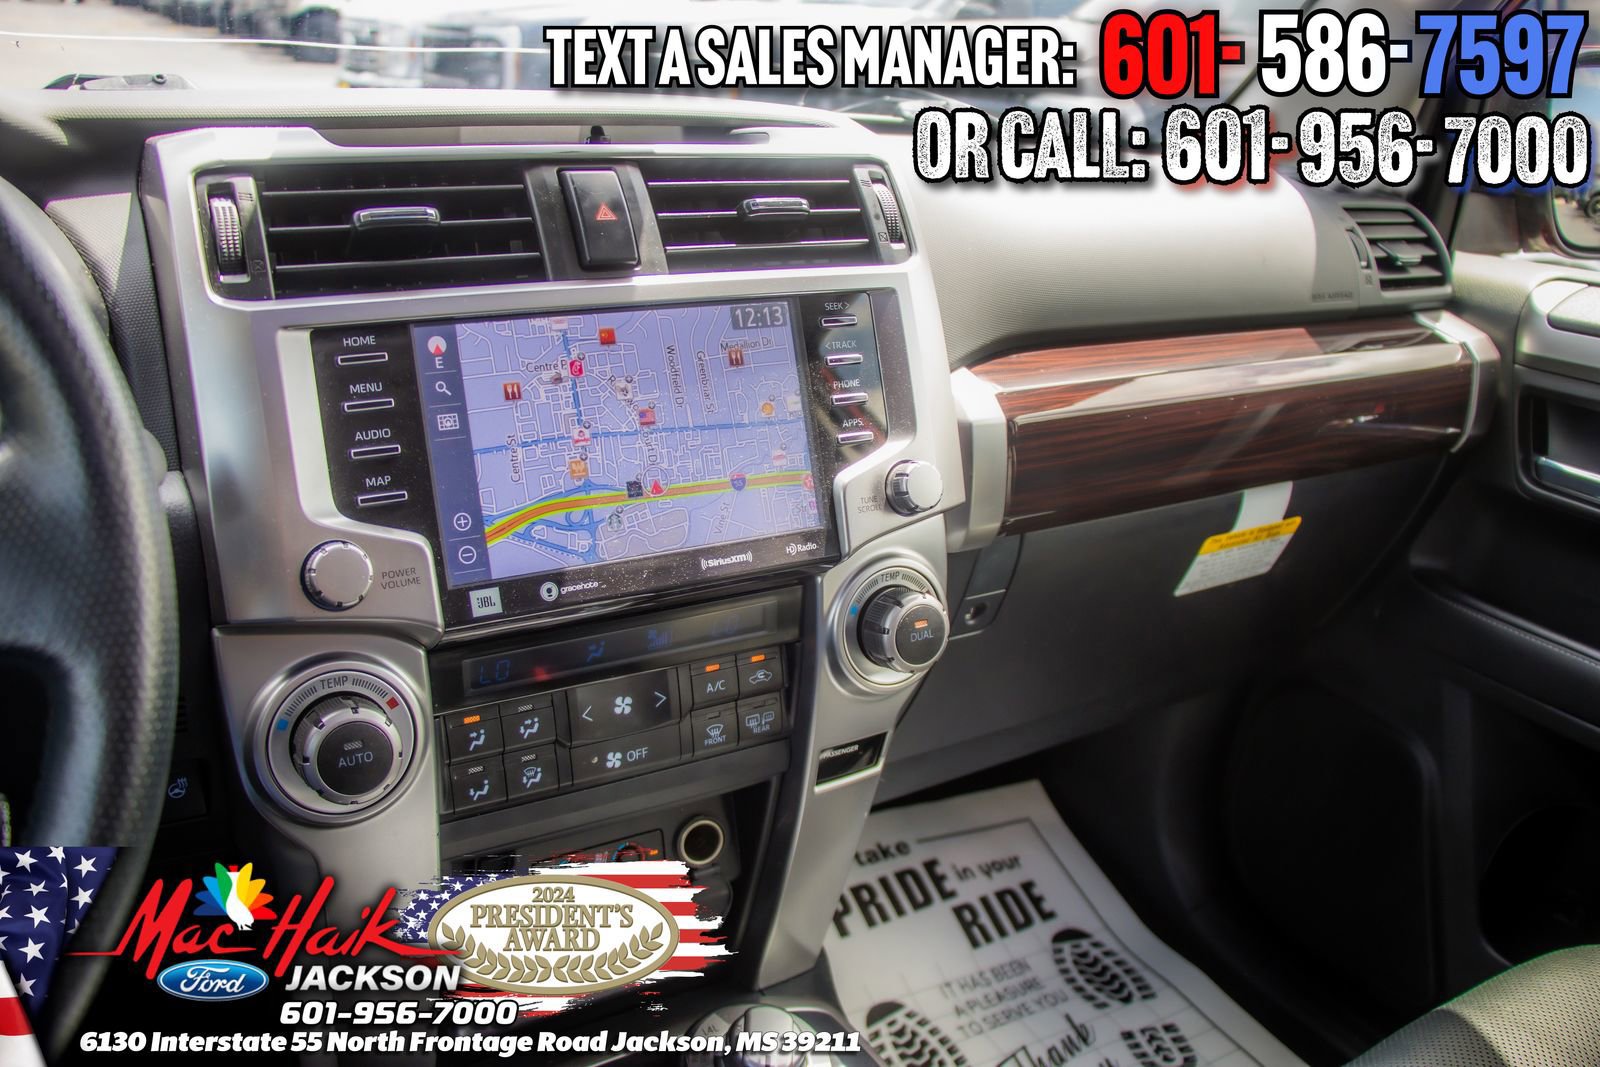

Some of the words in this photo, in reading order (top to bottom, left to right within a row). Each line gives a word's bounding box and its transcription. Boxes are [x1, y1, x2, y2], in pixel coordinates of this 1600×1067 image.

[824, 302, 843, 311] SEEK
[735, 306, 784, 328] 12:13
[343, 335, 376, 347] HOME
[720, 339, 759, 351] Medallion
[832, 340, 857, 349] TRACK
[435, 357, 444, 369] E
[526, 363, 558, 373] Centre
[666, 344, 682, 398] Woodfield
[675, 397, 683, 409] Dr
[697, 350, 713, 402] Greenbriar
[350, 382, 383, 394] MENU
[833, 378, 861, 389] PHONE
[842, 418, 863, 428] APPS
[355, 428, 391, 441] AUDIO
[507, 433, 517, 446] St
[640, 430, 655, 454] ourt
[510, 447, 521, 482] Centre
[365, 475, 391, 488] MAP
[860, 496, 878, 505] TUNE
[857, 503, 883, 514] SCROLL
[713, 513, 727, 535] Vine
[797, 542, 817, 553] Radio
[382, 567, 416, 580] POWER
[880, 571, 901, 584] TEMP
[380, 577, 421, 590] VOLUME
[477, 595, 496, 609] JBL
[910, 630, 933, 642] DUAL
[319, 675, 349, 691] TEMP
[707, 679, 726, 694] A/C
[753, 722, 771, 734] REAR
[704, 734, 726, 746] FRONT
[338, 751, 374, 769] AUTO
[626, 747, 649, 763] OFF
[855, 840, 912, 867] take
[833, 858, 958, 938] PRIDE
[953, 862, 977, 883] in
[979, 854, 1022, 881] your
[952, 879, 1058, 950] RIDE
[991, 957, 1033, 981] BEEN
[967, 976, 1045, 1012] PLEASURE
[982, 1001, 1036, 1029] SERVE
